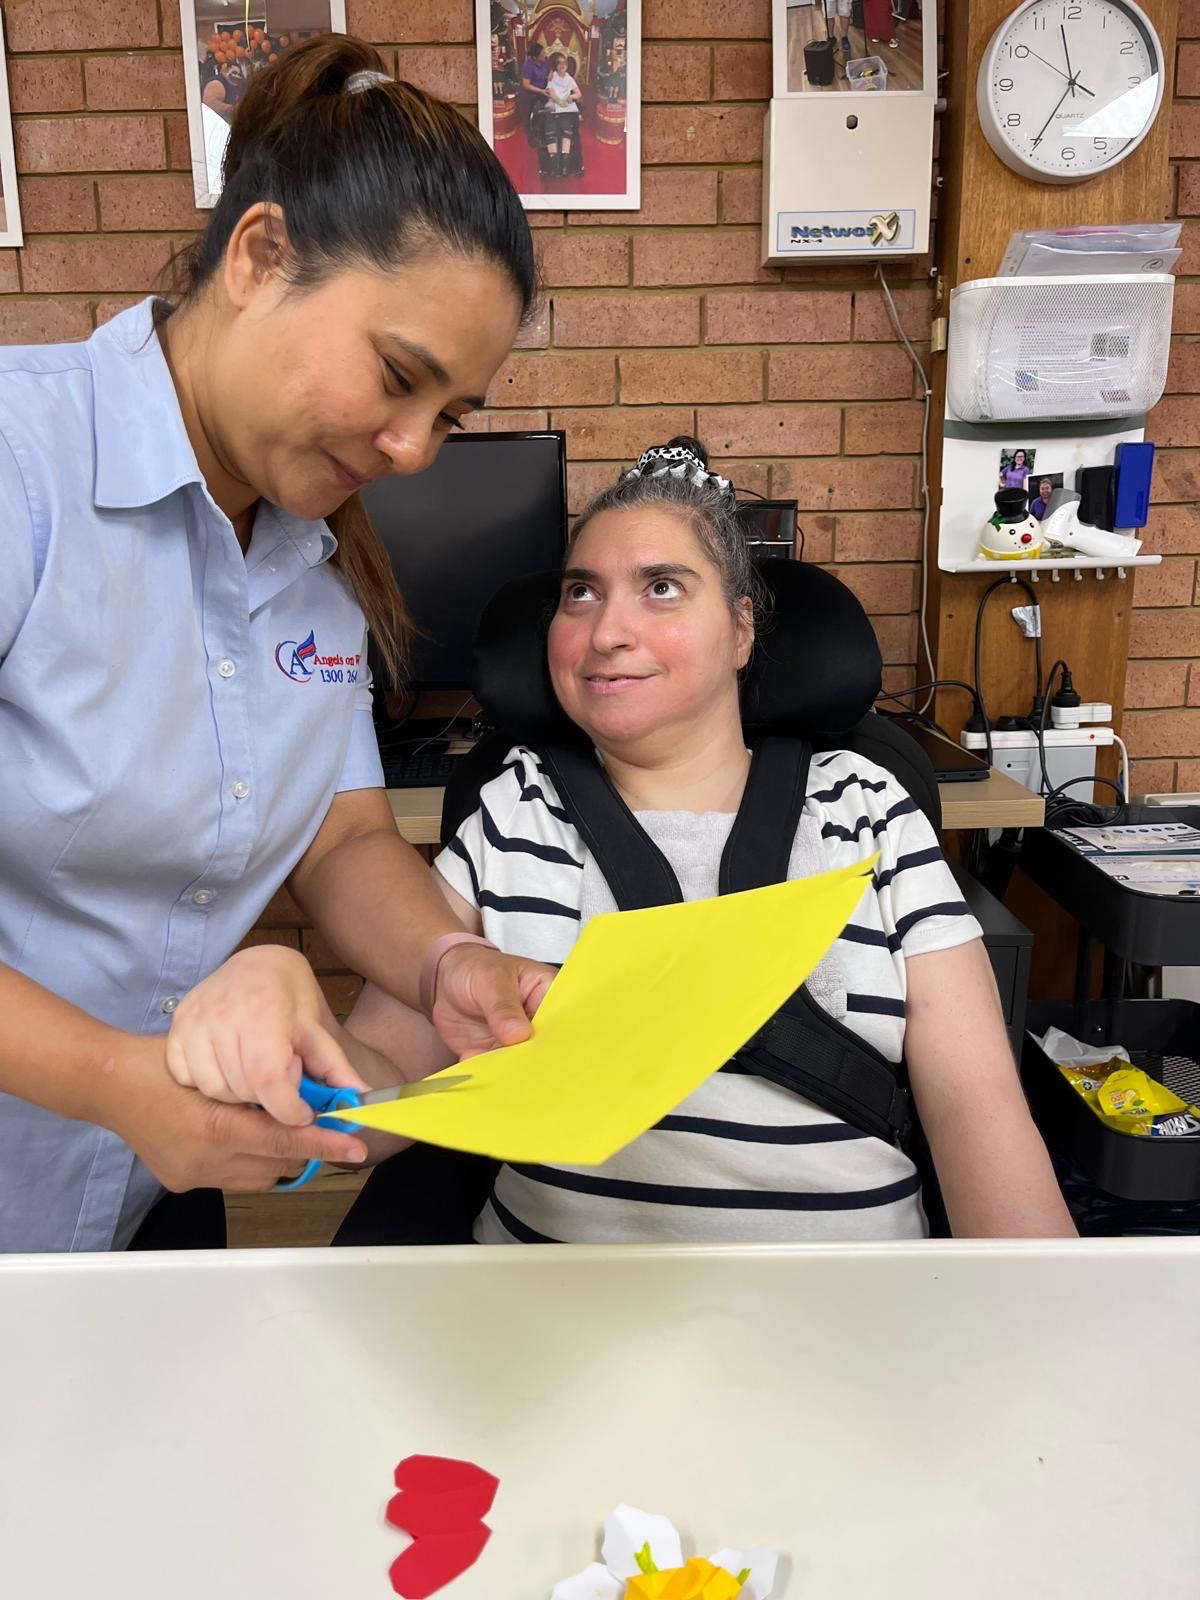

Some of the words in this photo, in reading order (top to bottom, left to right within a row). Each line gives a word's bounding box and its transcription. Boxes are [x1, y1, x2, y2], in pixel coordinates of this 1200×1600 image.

[1062, 6, 1082, 20] 12
[1034, 16, 1046, 31] 11
[1009, 45, 1030, 59] 10
[1119, 41, 1134, 55] 2
[998, 78, 1014, 92] 9
[1006, 113, 1021, 127] 8
[1093, 137, 1107, 150] 5
[1061, 147, 1075, 161] 6
[313, 654, 344, 668] Angels
[345, 657, 354, 666] on
[320, 669, 344, 683] 1300
